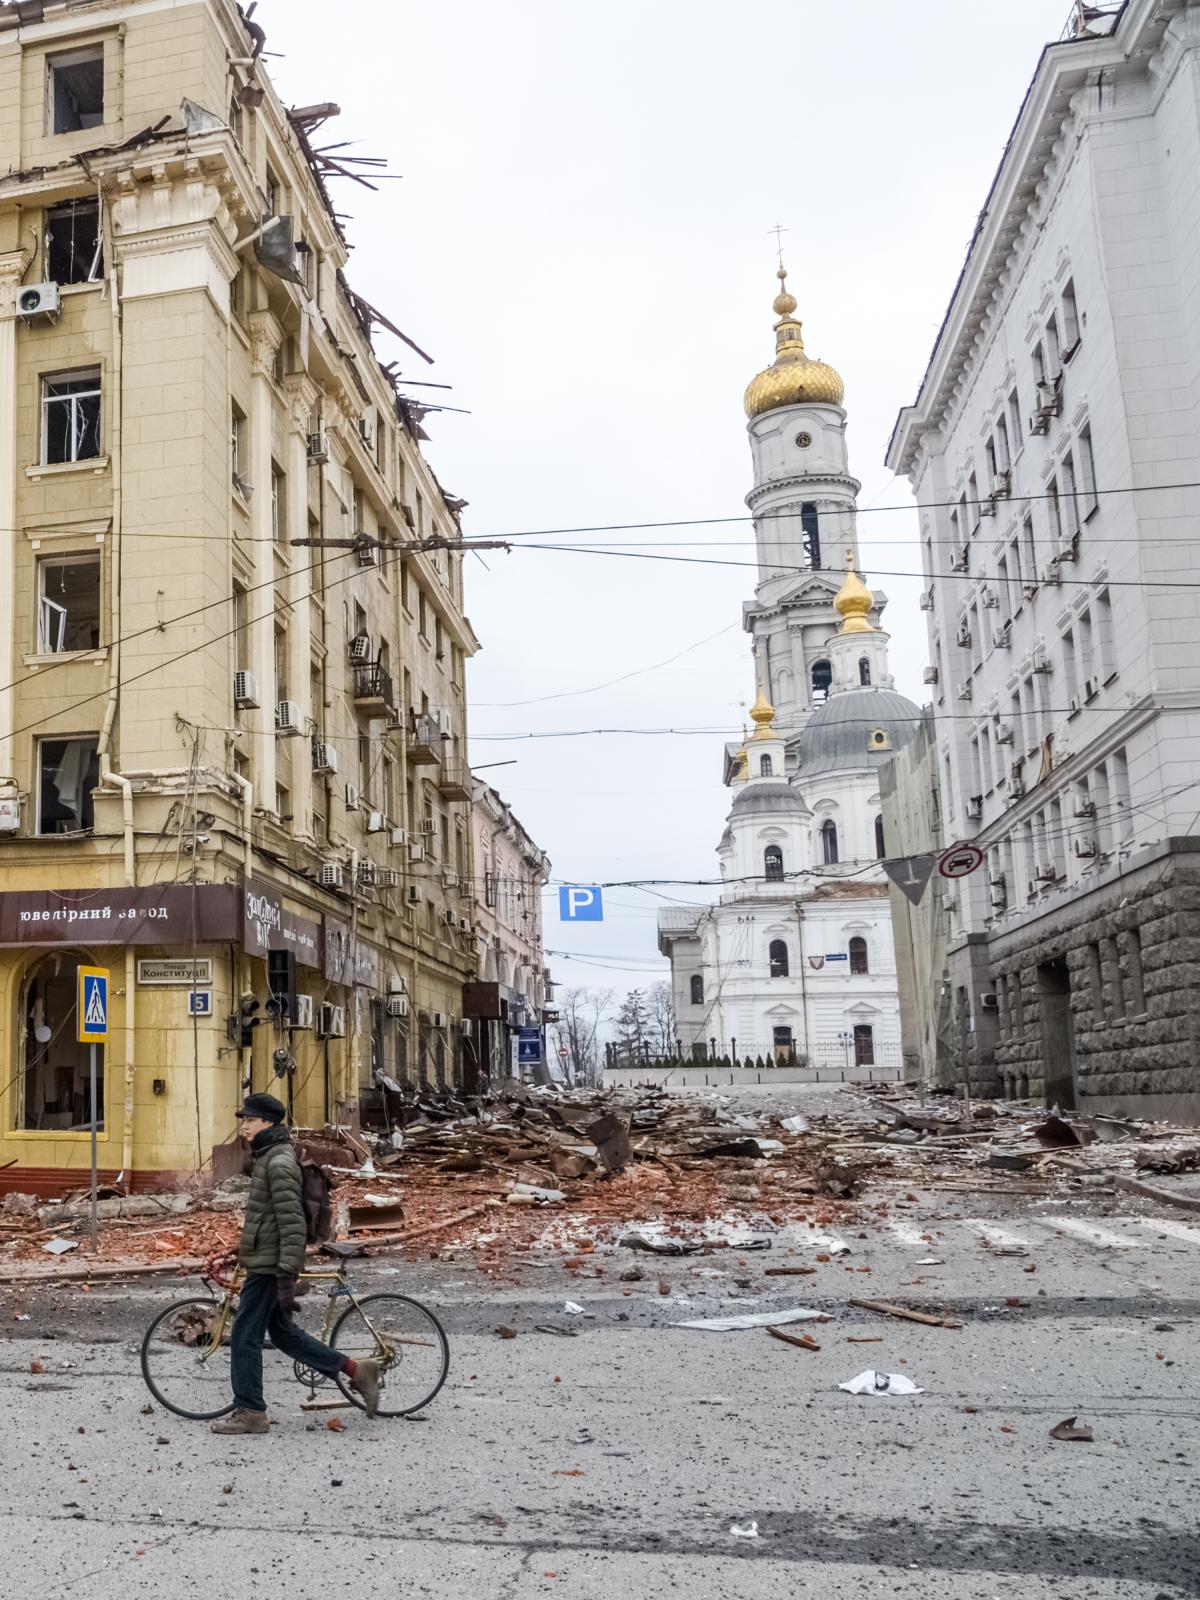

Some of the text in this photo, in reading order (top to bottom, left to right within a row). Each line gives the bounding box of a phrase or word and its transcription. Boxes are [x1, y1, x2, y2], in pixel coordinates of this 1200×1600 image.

[569, 888, 594, 917] P
[20, 906, 112, 922] ювелірний
[143, 968, 207, 978] Конституції
[194, 996, 204, 1010] 5
